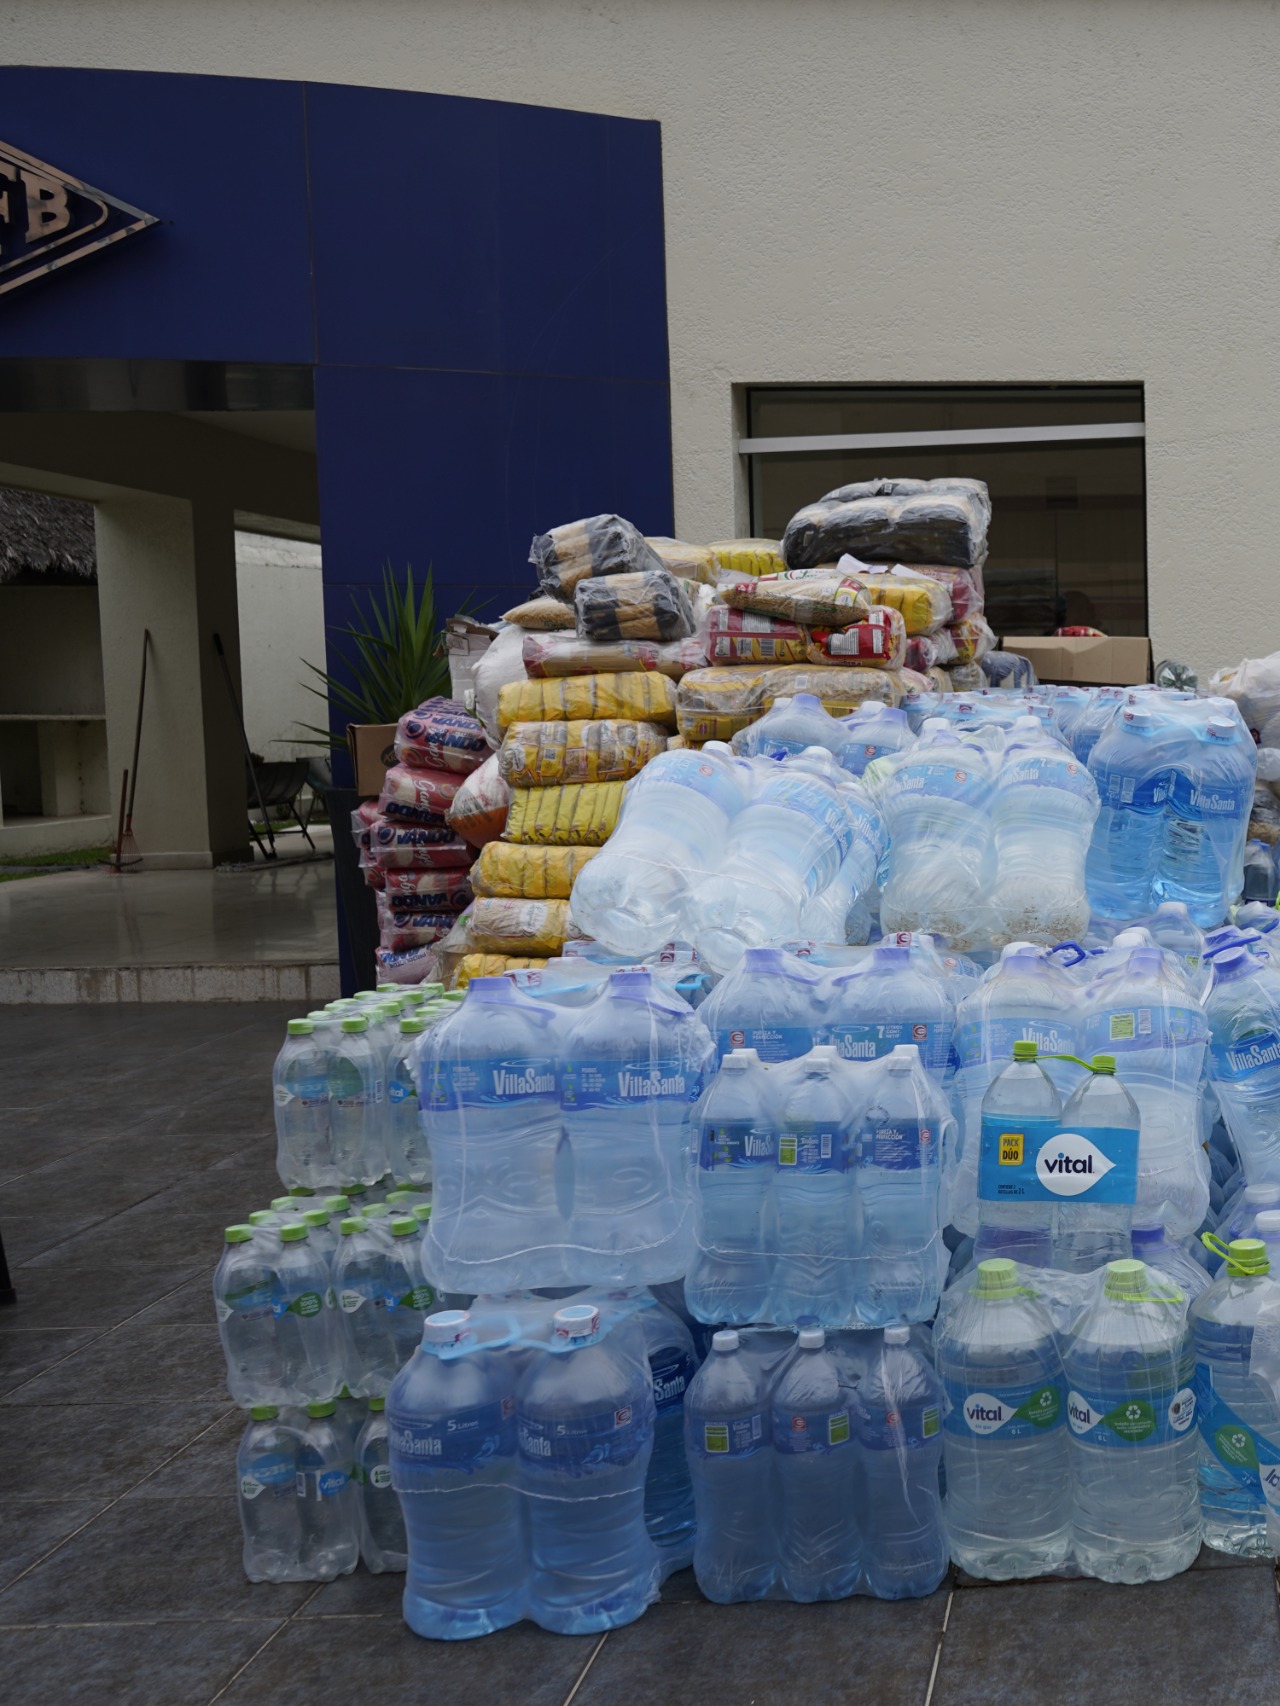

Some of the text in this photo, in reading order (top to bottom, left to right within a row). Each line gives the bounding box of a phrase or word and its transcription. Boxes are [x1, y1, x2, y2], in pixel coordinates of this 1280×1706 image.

[877, 1026, 884, 1038] 7
[492, 1068, 555, 1095] VillaSanta
[618, 1070, 685, 1098] VillaSanta
[1003, 1138, 1019, 1147] PACK
[1003, 1148, 1019, 1160] DÚO
[1044, 1153, 1093, 1174] vital
[966, 1404, 1002, 1421] vital
[1068, 1402, 1091, 1424] vital
[447, 1420, 478, 1431] 5 Litros
[556, 1425, 566, 1436] 5
[321, 1477, 345, 1489] vital
